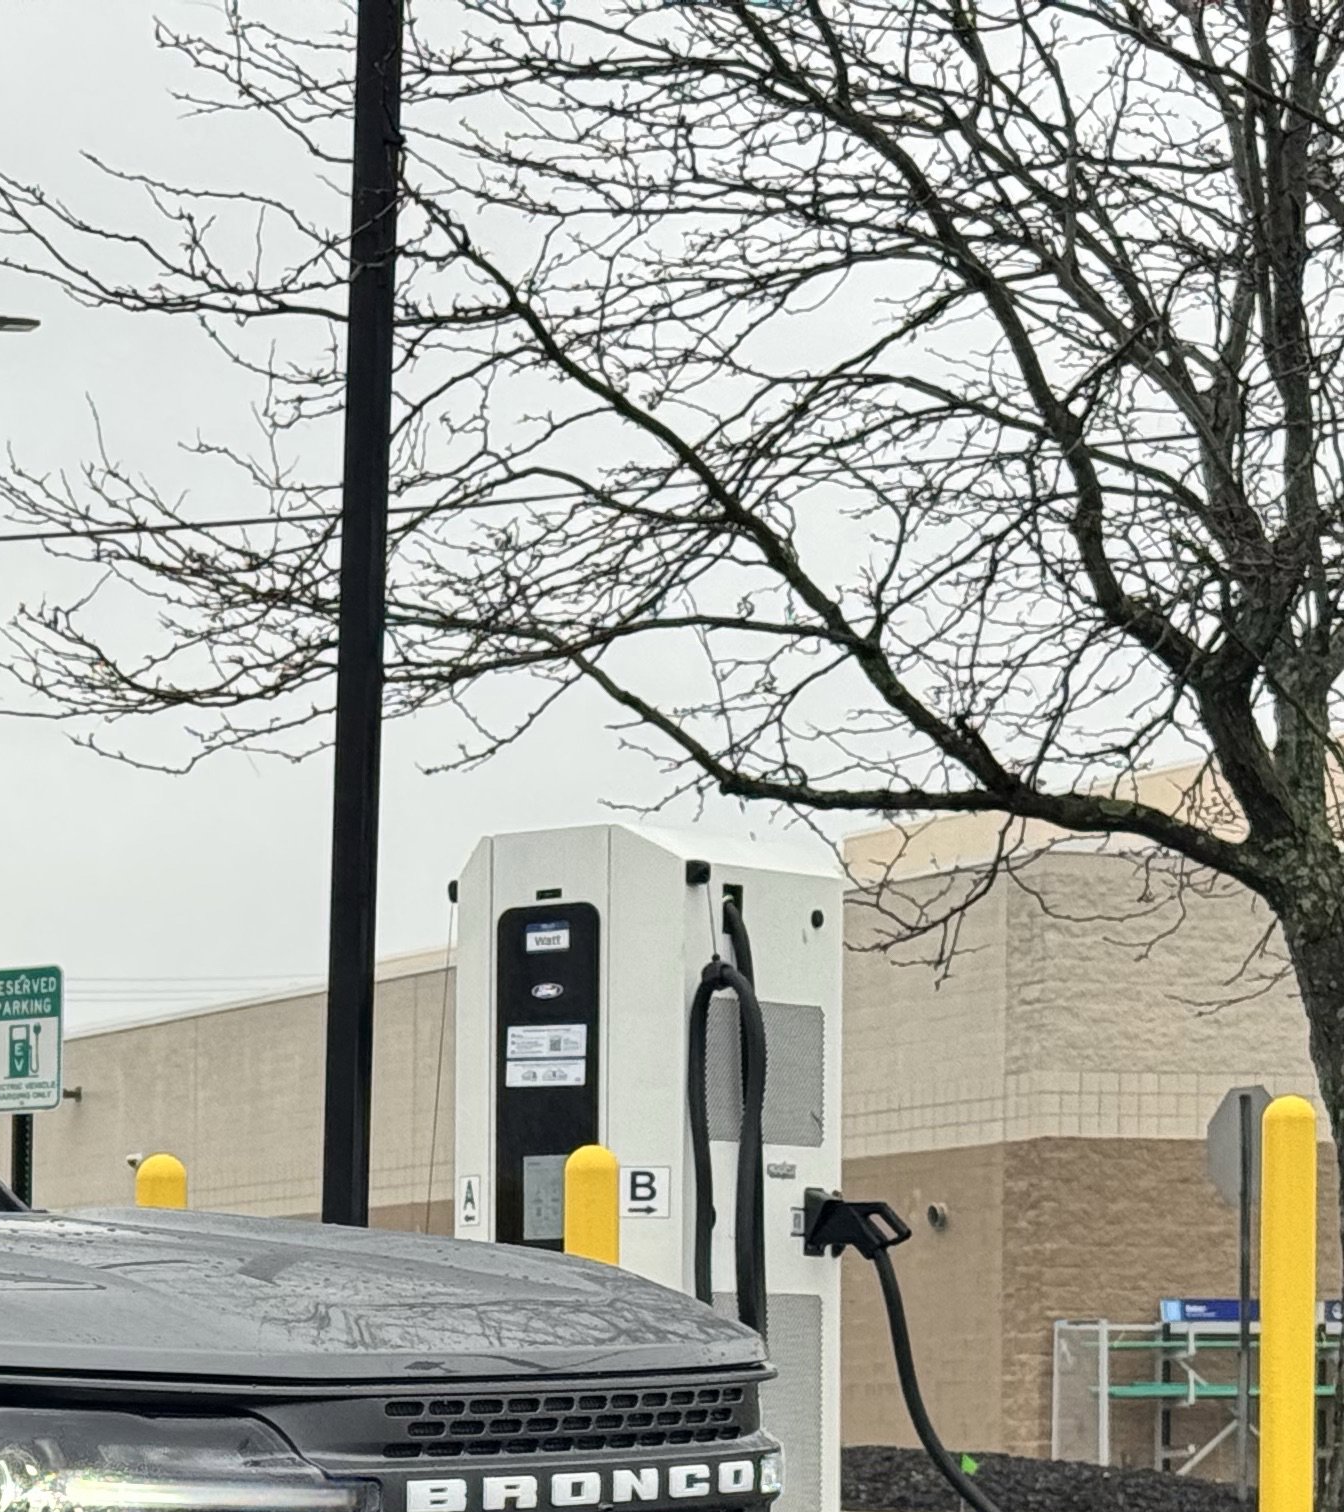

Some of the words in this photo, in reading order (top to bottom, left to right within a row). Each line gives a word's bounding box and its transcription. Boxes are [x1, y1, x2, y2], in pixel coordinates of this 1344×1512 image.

[14, 1042, 25, 1072] EV
[464, 1180, 476, 1210] A
[629, 1170, 657, 1202] B
